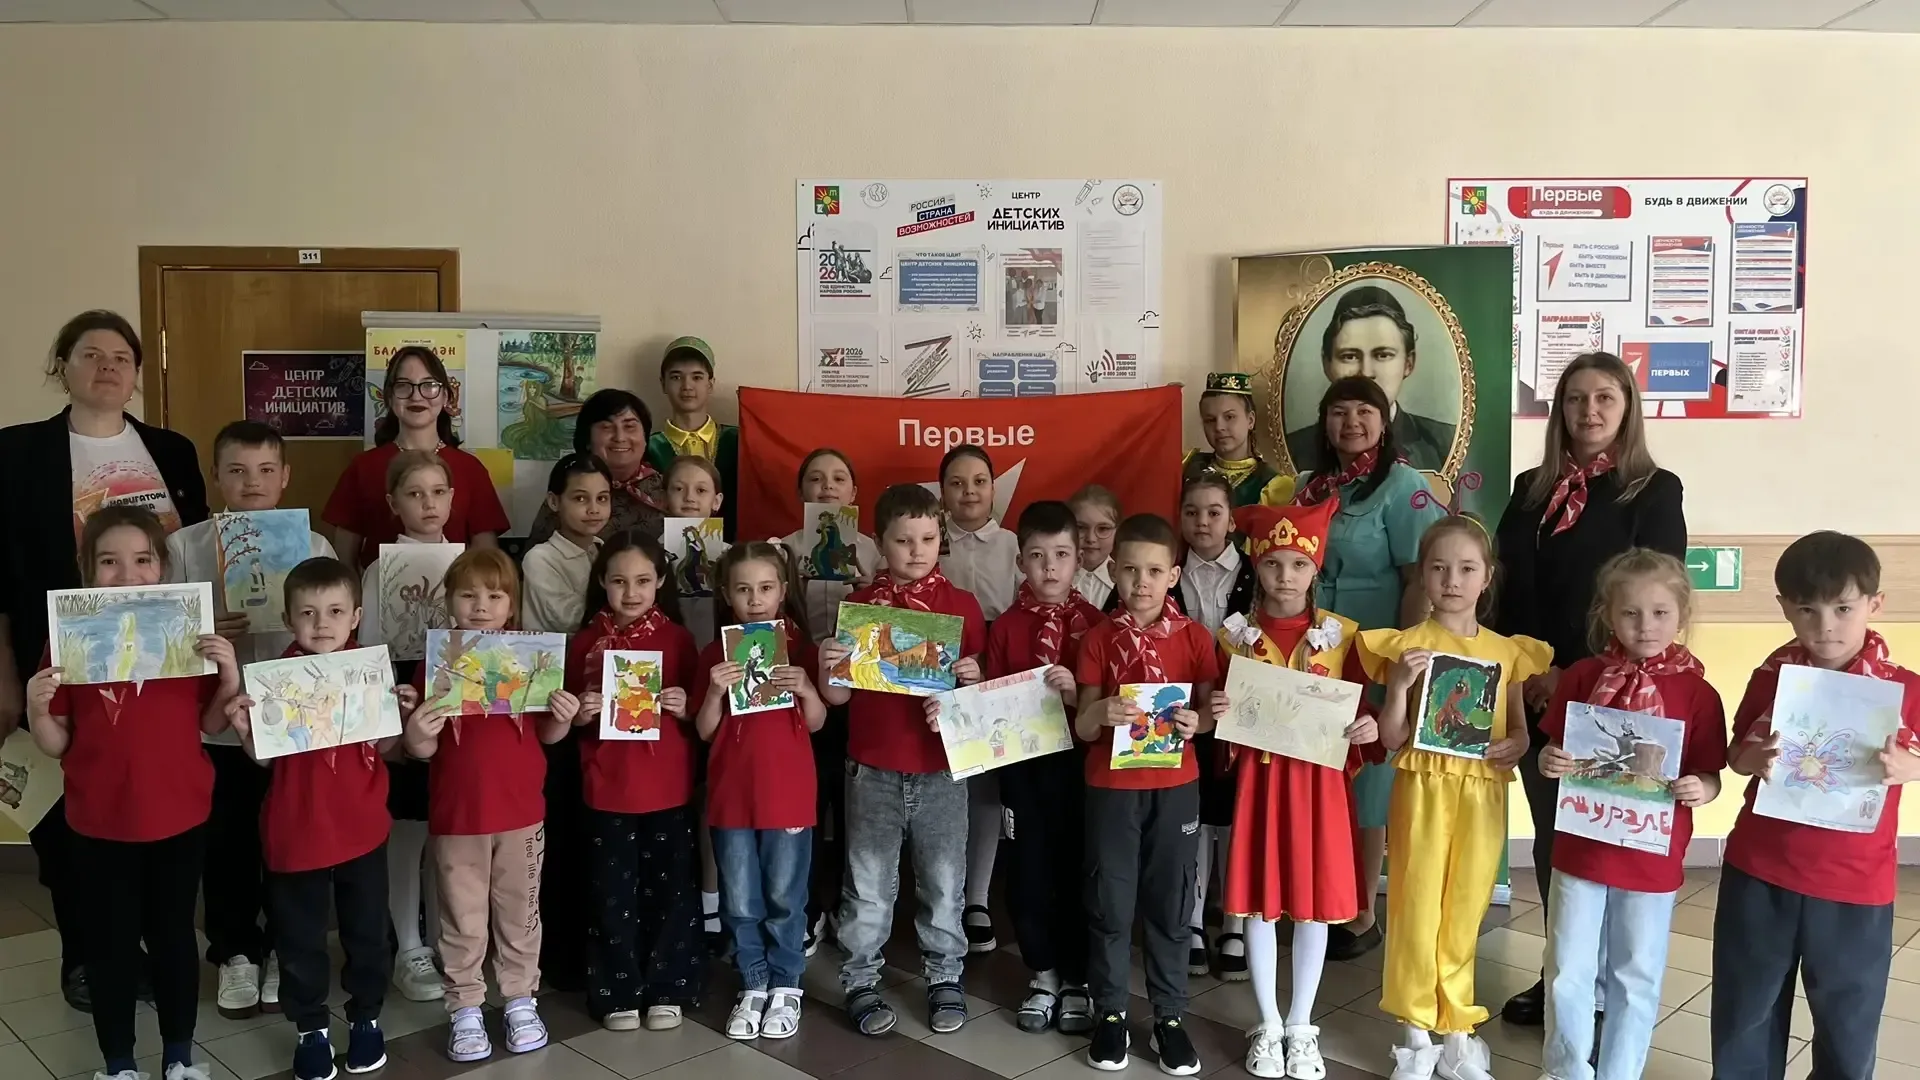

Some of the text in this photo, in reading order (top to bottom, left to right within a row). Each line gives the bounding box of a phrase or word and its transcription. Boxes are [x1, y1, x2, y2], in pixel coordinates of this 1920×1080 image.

[1011, 192, 1041, 200] ЦЕНТР
[1531, 186, 1603, 206] Первые
[1644, 197, 1748, 207] БУДЬ В ДВИЖЕНИИ
[910, 197, 946, 212] РОССИЯ
[918, 207, 953, 221] СТРАНА
[992, 207, 1060, 219] ДЕТСКИХ
[899, 212, 971, 237] ВОЗМОЖНОСТЕЙ
[987, 220, 1065, 232] ИНИЦИАТИВ
[284, 370, 325, 382] ЦЕНТР
[272, 386, 338, 400] ДЕТСКИХ
[265, 401, 346, 414] ИНИЦИАТИВ
[899, 418, 1035, 453] Первые
[525, 837, 534, 858] free
